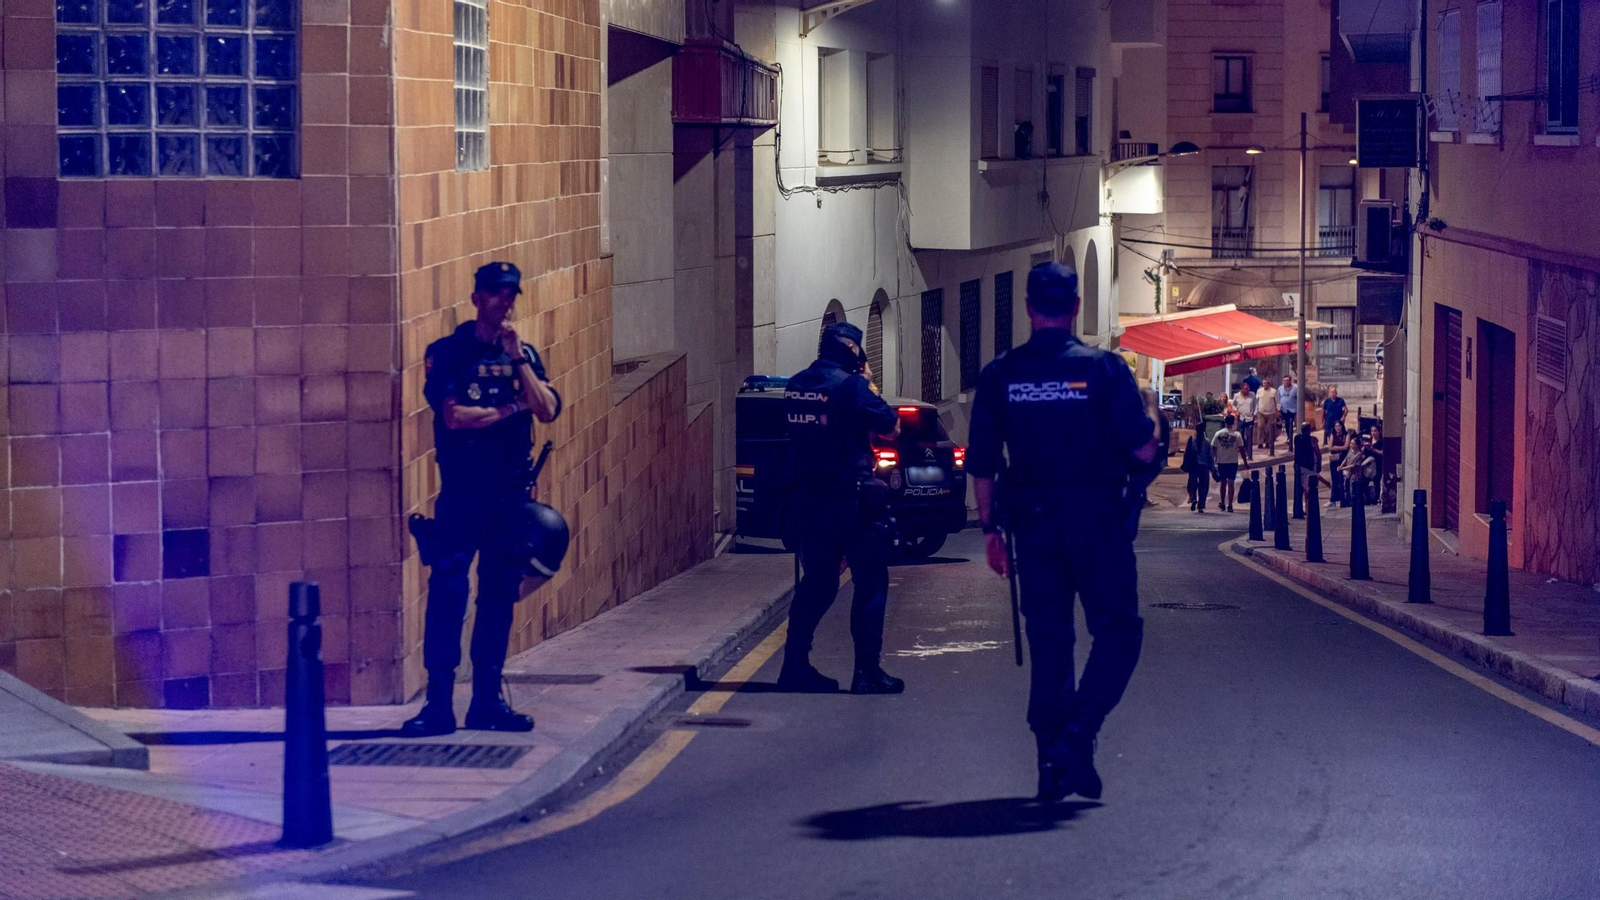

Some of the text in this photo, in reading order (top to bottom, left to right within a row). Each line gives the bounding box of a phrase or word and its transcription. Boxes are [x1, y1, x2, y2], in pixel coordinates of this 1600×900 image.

[1008, 381, 1070, 392] POLICIA
[785, 390, 824, 401] POLICIA
[1009, 390, 1088, 402] NACIONAL
[787, 413, 819, 424] U.I.P.
[904, 488, 943, 496] POLICIA
